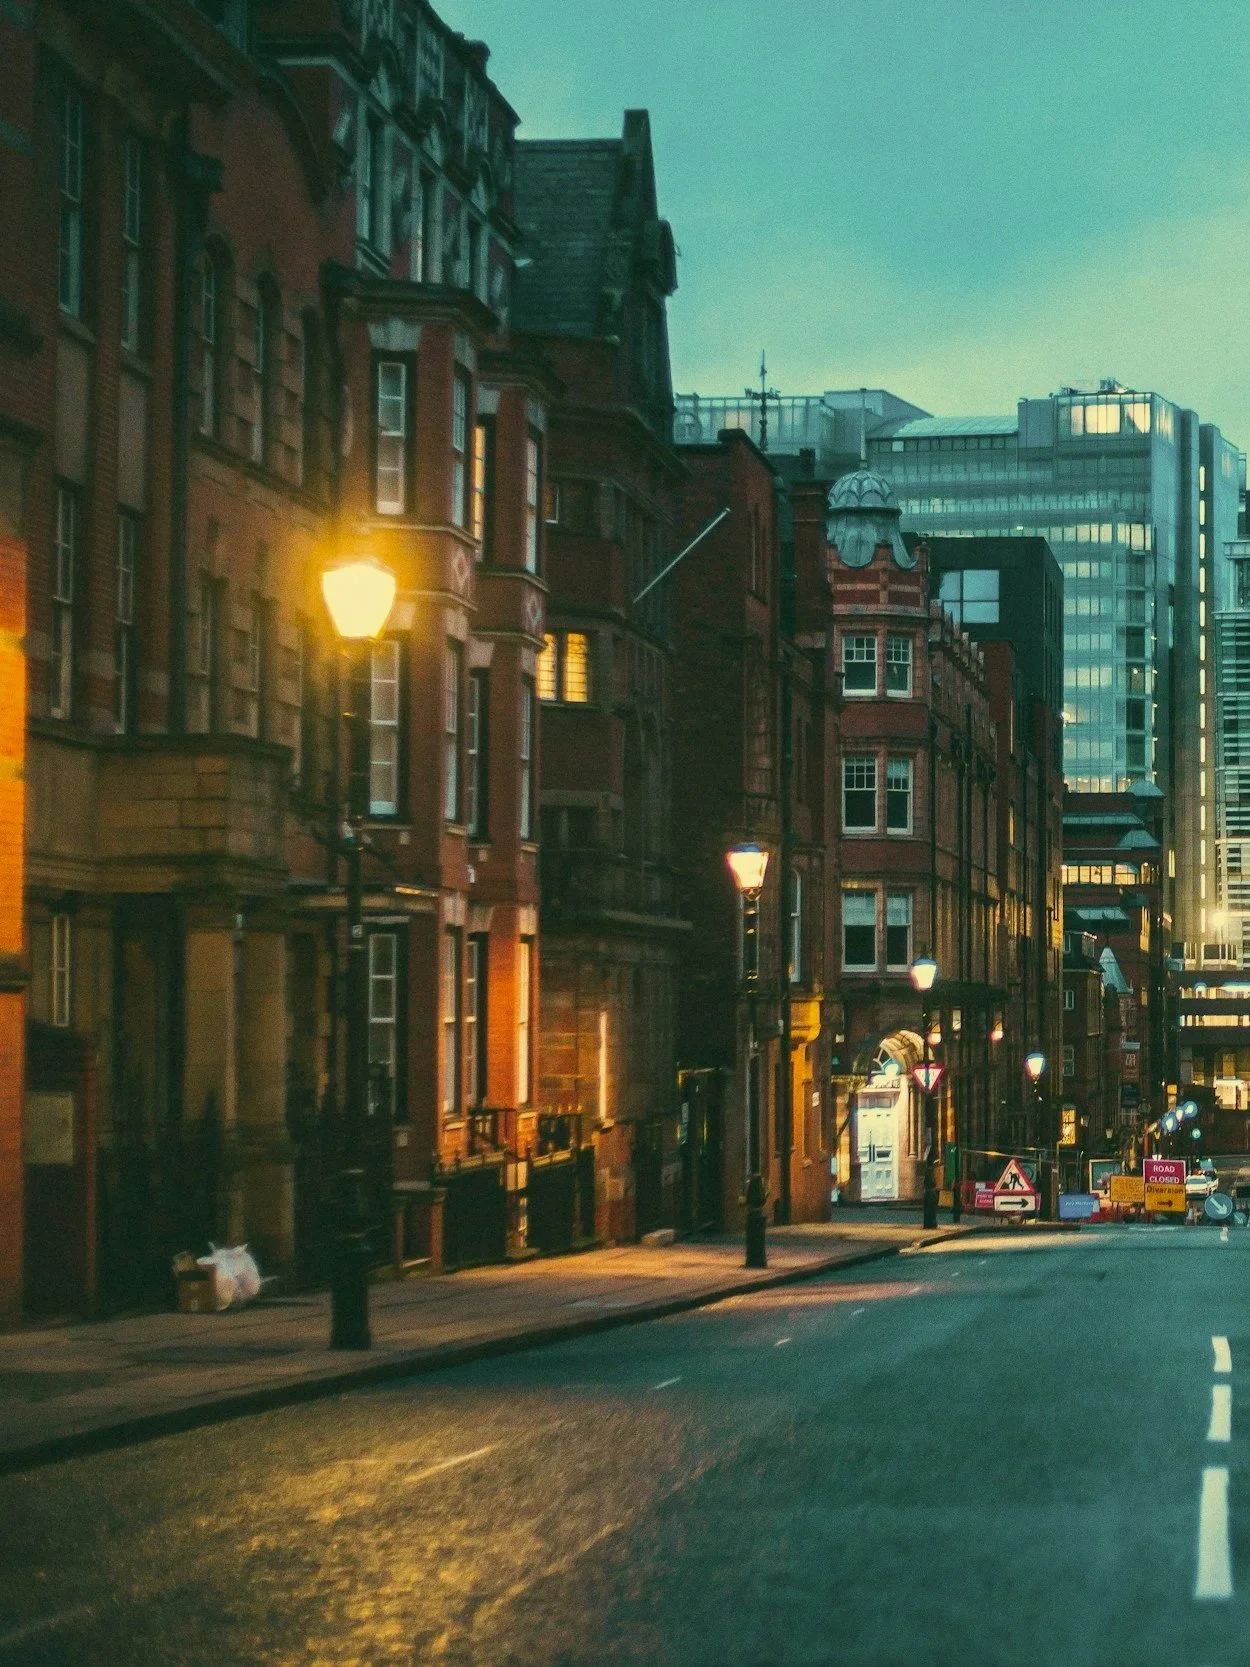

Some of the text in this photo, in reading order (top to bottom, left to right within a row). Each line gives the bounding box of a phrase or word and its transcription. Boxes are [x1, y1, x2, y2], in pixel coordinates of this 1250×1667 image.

[1153, 1165, 1176, 1173] ROAD
[1149, 1176, 1180, 1184] CLOSED
[1146, 1185, 1184, 1194] Diversion
